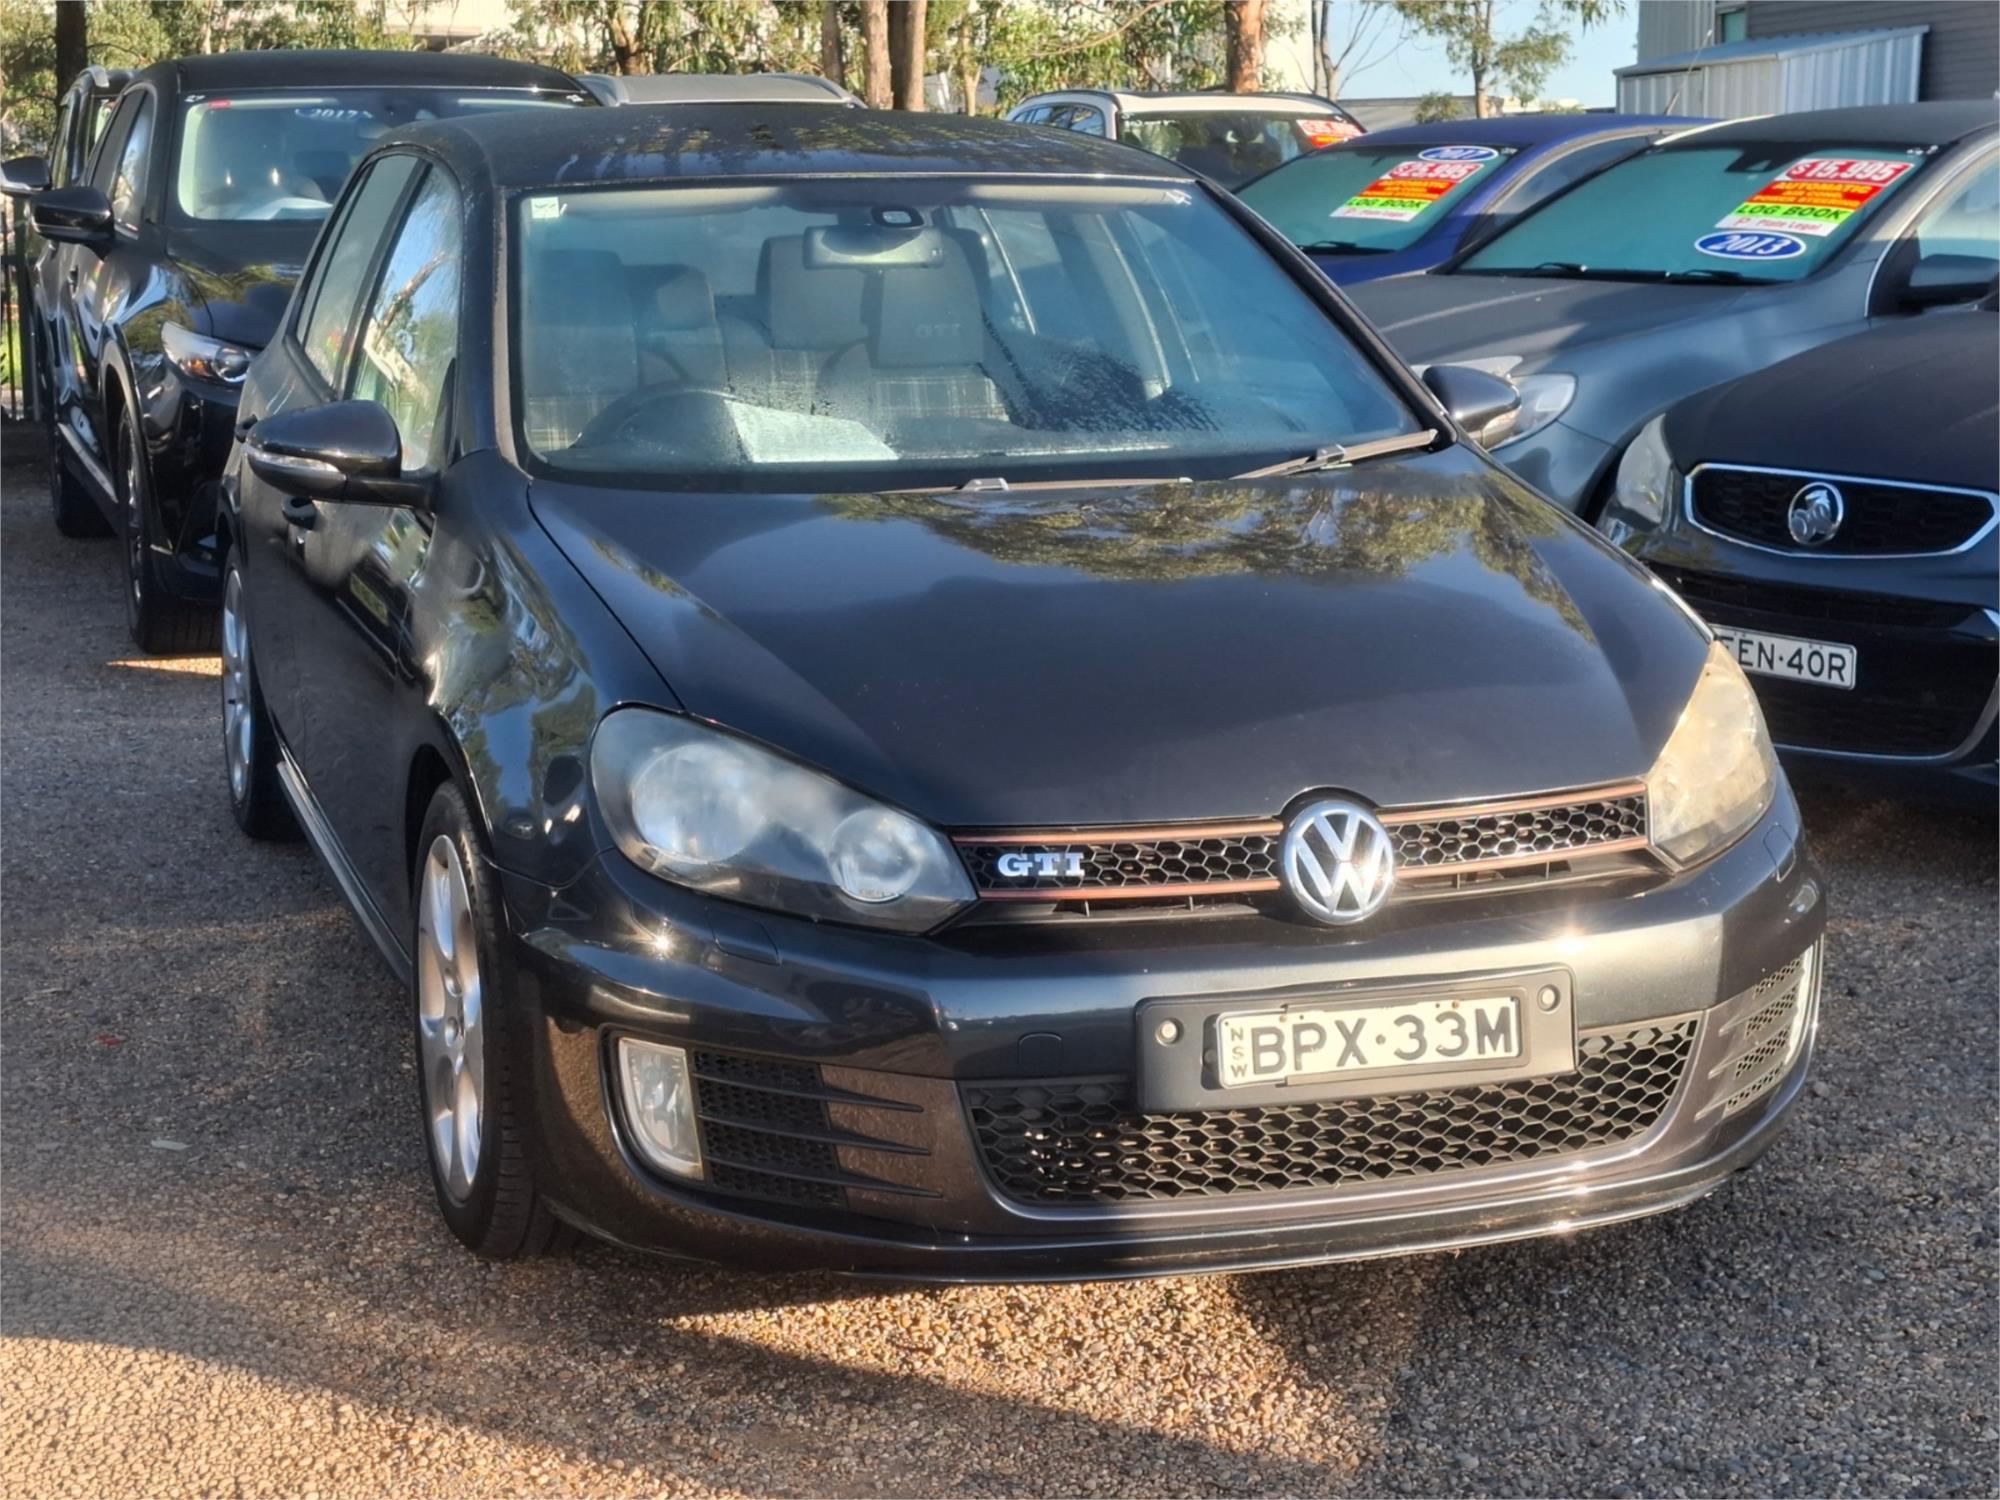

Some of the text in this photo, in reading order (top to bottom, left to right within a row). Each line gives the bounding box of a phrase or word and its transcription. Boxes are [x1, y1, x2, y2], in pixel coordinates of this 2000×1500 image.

[1792, 160, 1904, 181] $15,995
[1773, 181, 1872, 194] AUTOMATIC
[1737, 204, 1849, 219] LOG BOOK
[1707, 234, 1792, 255] 2013
[997, 852, 1085, 877] GTI
